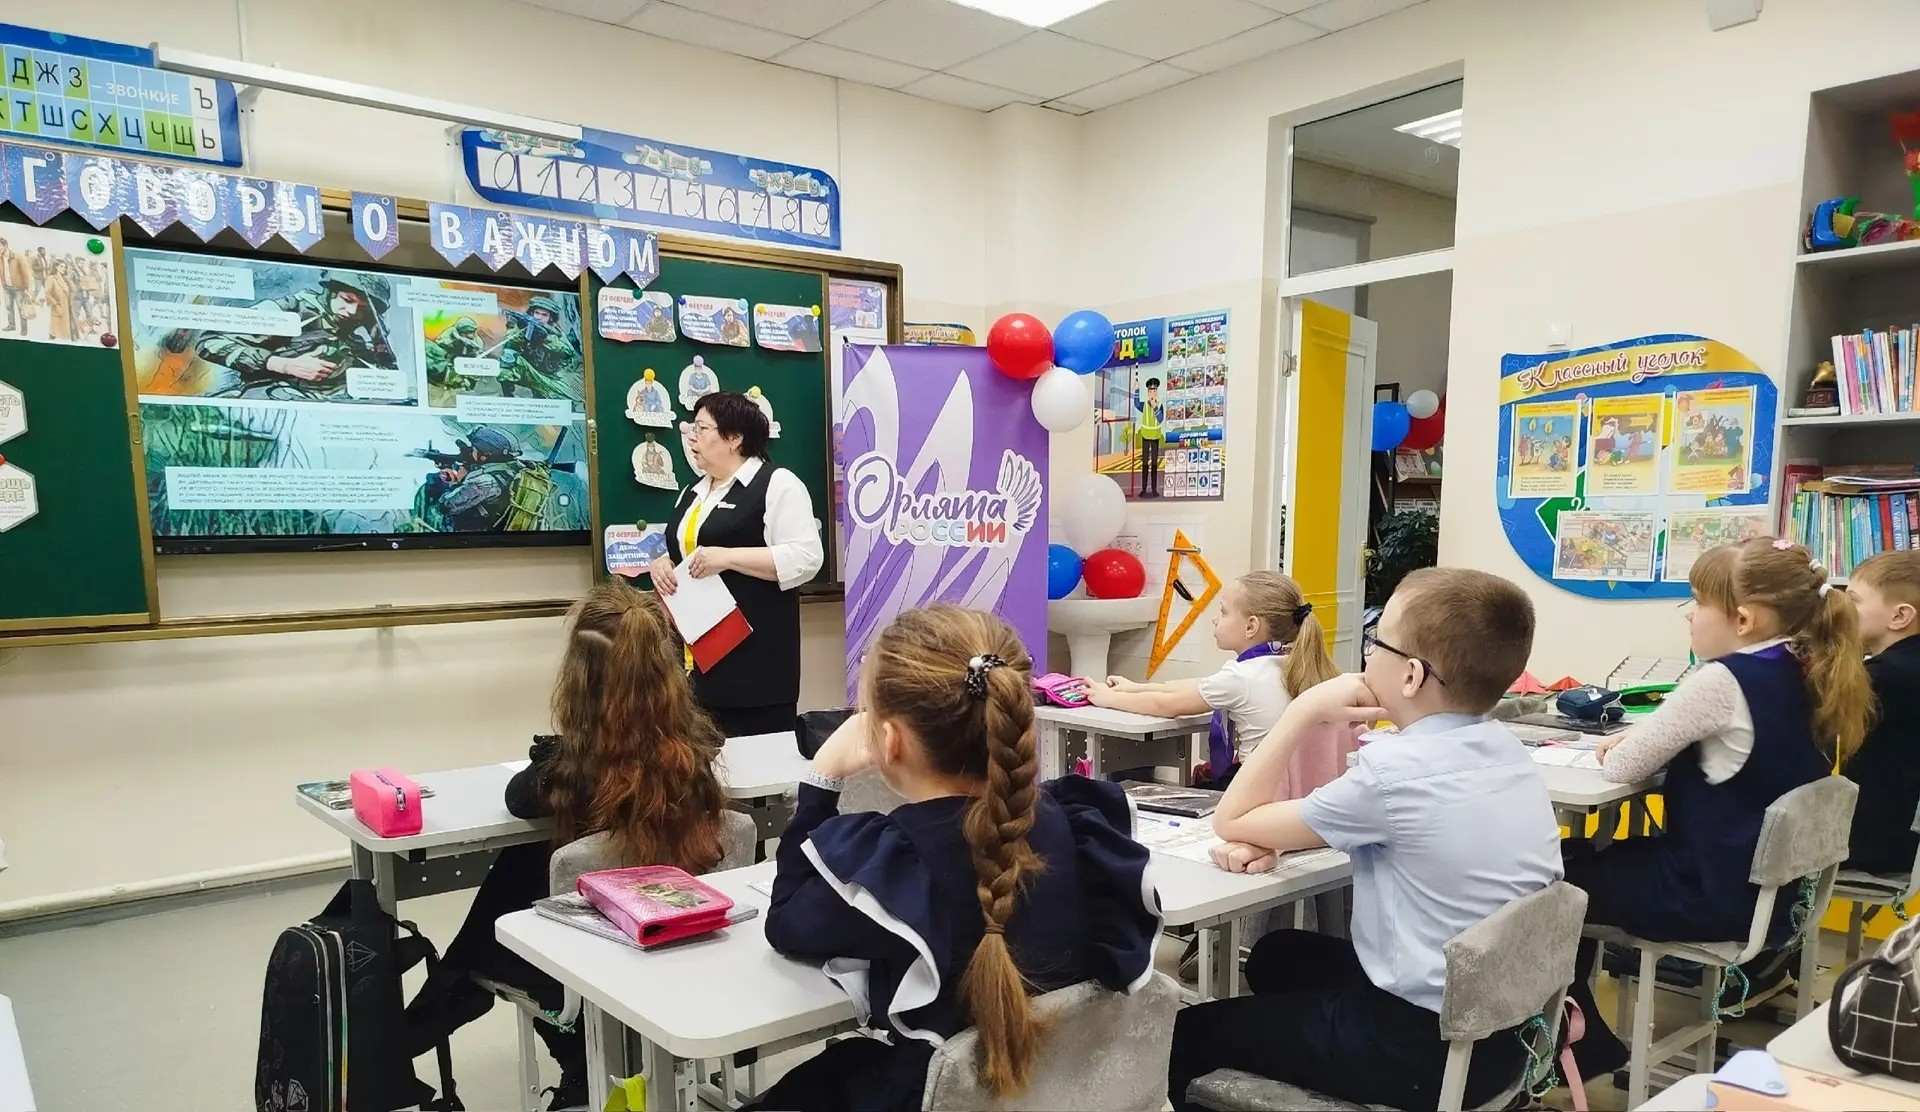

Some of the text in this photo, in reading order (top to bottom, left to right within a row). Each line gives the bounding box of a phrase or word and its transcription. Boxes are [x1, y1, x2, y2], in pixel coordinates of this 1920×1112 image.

[12, 58, 30, 85] Д
[35, 60, 60, 85] Ж
[105, 82, 180, 105] ЗВОНКИЕ
[194, 87, 213, 109] Ъ
[16, 100, 215, 152] Т Ш С Х Ц Ч Щ Ь
[537, 159, 555, 195] 1
[576, 165, 596, 202] 2
[614, 171, 634, 207] 3
[650, 176, 667, 212] 4
[684, 182, 703, 217] 5
[718, 187, 736, 222] 6
[752, 193, 767, 227] 7
[782, 198, 798, 231] 8
[813, 203, 829, 235] 9
[362, 202, 388, 242] О
[440, 211, 655, 274] ВАЖНОМ
[1517, 347, 1706, 391] Классный уголок
[854, 455, 1007, 532] Орлята
[608, 552, 650, 560] ЗАЩИТНИКА
[893, 520, 1006, 543] РОССИИ
[609, 560, 650, 569] ОТЕЧЕСТВА
